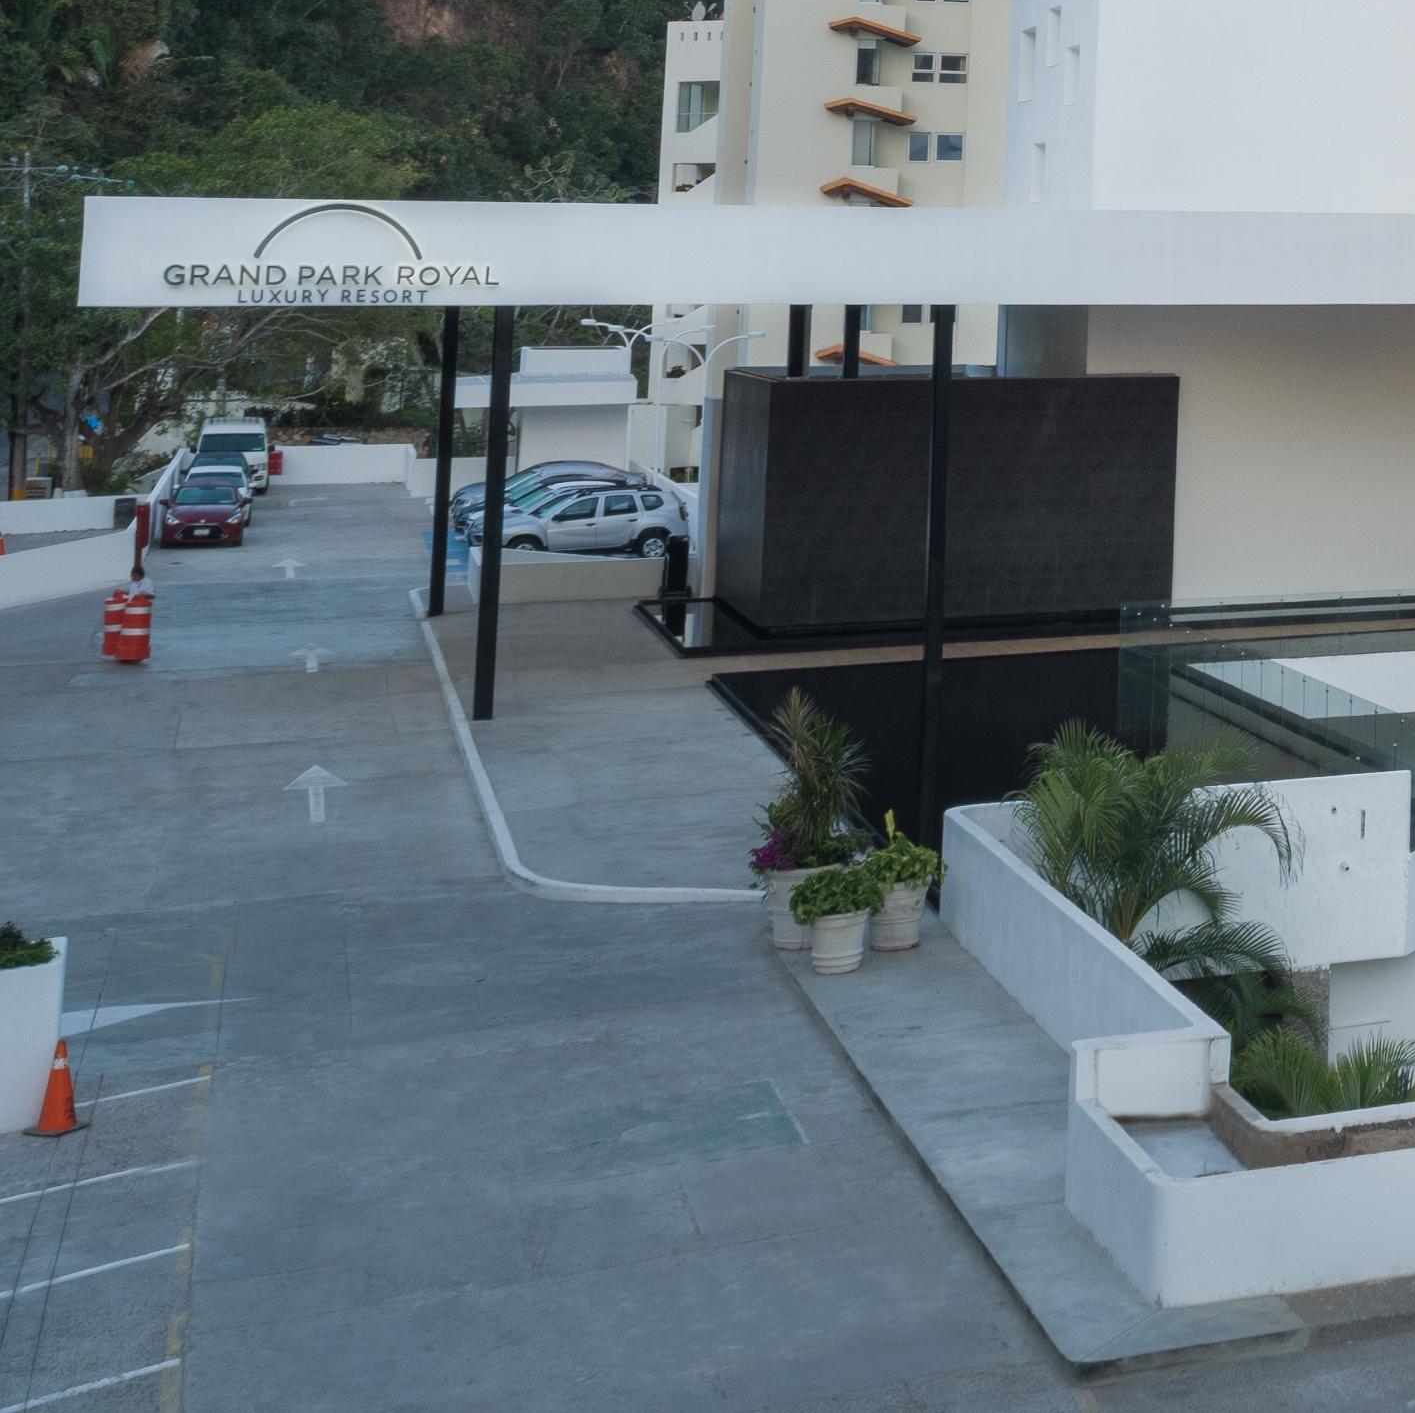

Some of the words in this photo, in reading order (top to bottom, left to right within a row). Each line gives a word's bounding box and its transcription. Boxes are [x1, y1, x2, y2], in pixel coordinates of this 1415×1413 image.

[162, 264, 287, 286] GRAND
[299, 265, 383, 286] PARK
[397, 265, 500, 286] ROYAL
[237, 289, 329, 304] LUXURY
[341, 289, 429, 304] RESORT
